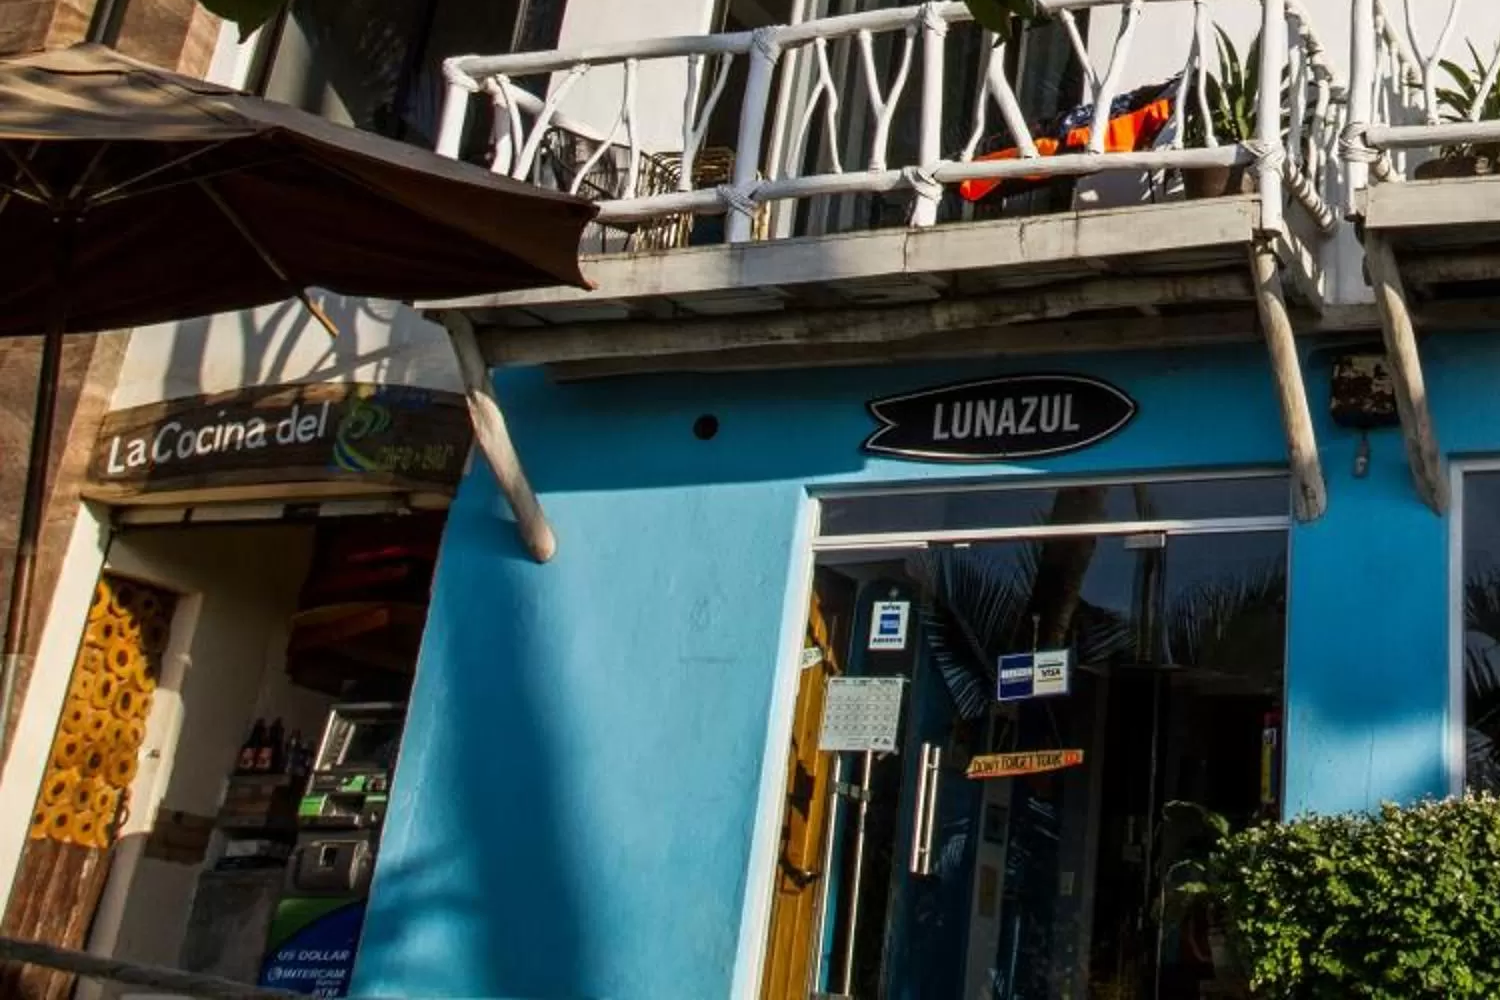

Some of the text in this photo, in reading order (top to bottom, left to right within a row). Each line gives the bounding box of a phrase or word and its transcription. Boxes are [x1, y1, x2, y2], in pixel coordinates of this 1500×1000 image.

[932, 393, 1080, 441] LUNAZUL
[107, 400, 329, 474] La Cocina del
[1041, 668, 1061, 677] VISA
[298, 949, 351, 961] DOLLAR
